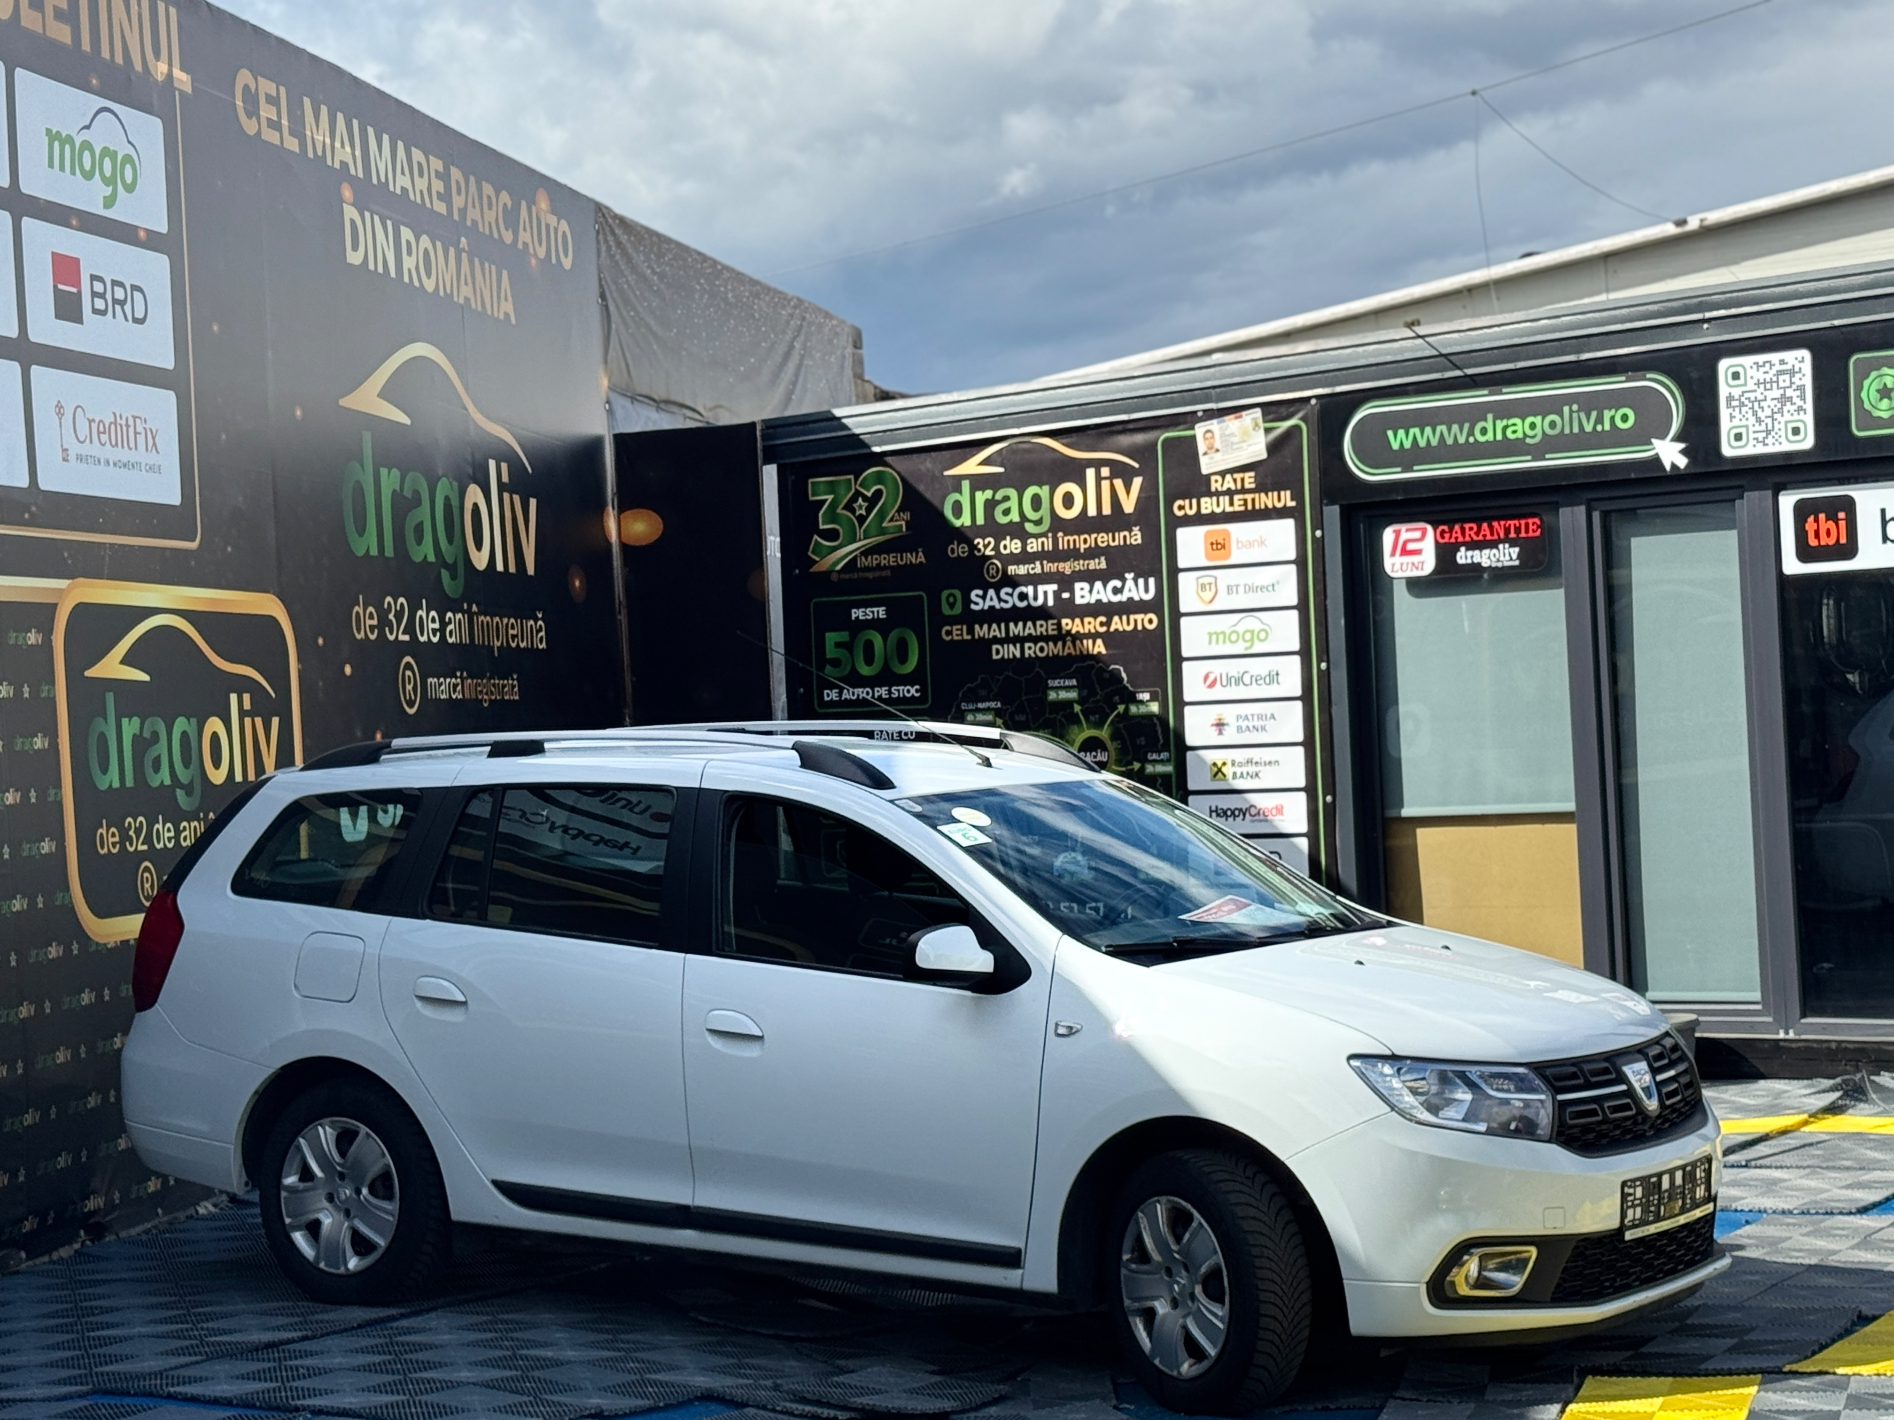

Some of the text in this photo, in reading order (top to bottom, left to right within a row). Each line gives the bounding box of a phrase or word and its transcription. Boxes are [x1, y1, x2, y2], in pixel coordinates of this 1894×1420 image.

[45, 127, 139, 210] mogo
[234, 68, 574, 271] CEL MAI MARE PARC AUTO
[342, 202, 516, 325] DIN ROMÂNIA
[89, 273, 149, 326] BRD
[72, 404, 160, 455] CreditFix
[1386, 404, 1635, 451] www.dragoliv.ro
[75, 453, 102, 467] PRIETEN
[1210, 471, 1256, 492] RATE
[342, 430, 537, 598] dragoliv
[807, 466, 905, 562] 32
[943, 467, 1144, 534] dragoliv
[1173, 490, 1296, 516] CU BULETINUL
[948, 525, 1142, 558] de 32 de ani împreună
[1389, 517, 1542, 559] 12 GARANTIE
[1805, 511, 1847, 548] tbi
[1209, 535, 1267, 552] tbi bank
[1456, 543, 1520, 567] dragoliv
[1007, 560, 1042, 576] marcă
[1043, 556, 1107, 575] înregistrată
[1391, 561, 1425, 573] LUNI
[970, 583, 1058, 611] SASCUT
[1074, 572, 1156, 605] BACĂU
[1200, 581, 1213, 593] BT
[1226, 584, 1241, 596] BT
[352, 595, 547, 657] de 32 de ani împreună
[851, 606, 887, 621] PESTE
[941, 613, 1158, 641] CEL MAI MARE PARC AUTO
[823, 627, 919, 678] 500
[992, 637, 1107, 660] DIN ROMÂNIA
[1207, 627, 1270, 651] mogo
[427, 671, 462, 701] marcă
[1219, 669, 1281, 688] UniCredit
[823, 685, 921, 702] DE AUTO PE STOC
[1236, 713, 1277, 724] PATRIA
[1236, 723, 1268, 734] BANK
[88, 691, 280, 811] dragoliv
[1231, 758, 1280, 769] Raiffeisen
[1231, 769, 1262, 781] BANK
[1208, 804, 1285, 821] HappyCredit
[96, 819, 120, 855] de
[125, 815, 148, 851] 32
[152, 814, 175, 850] de
